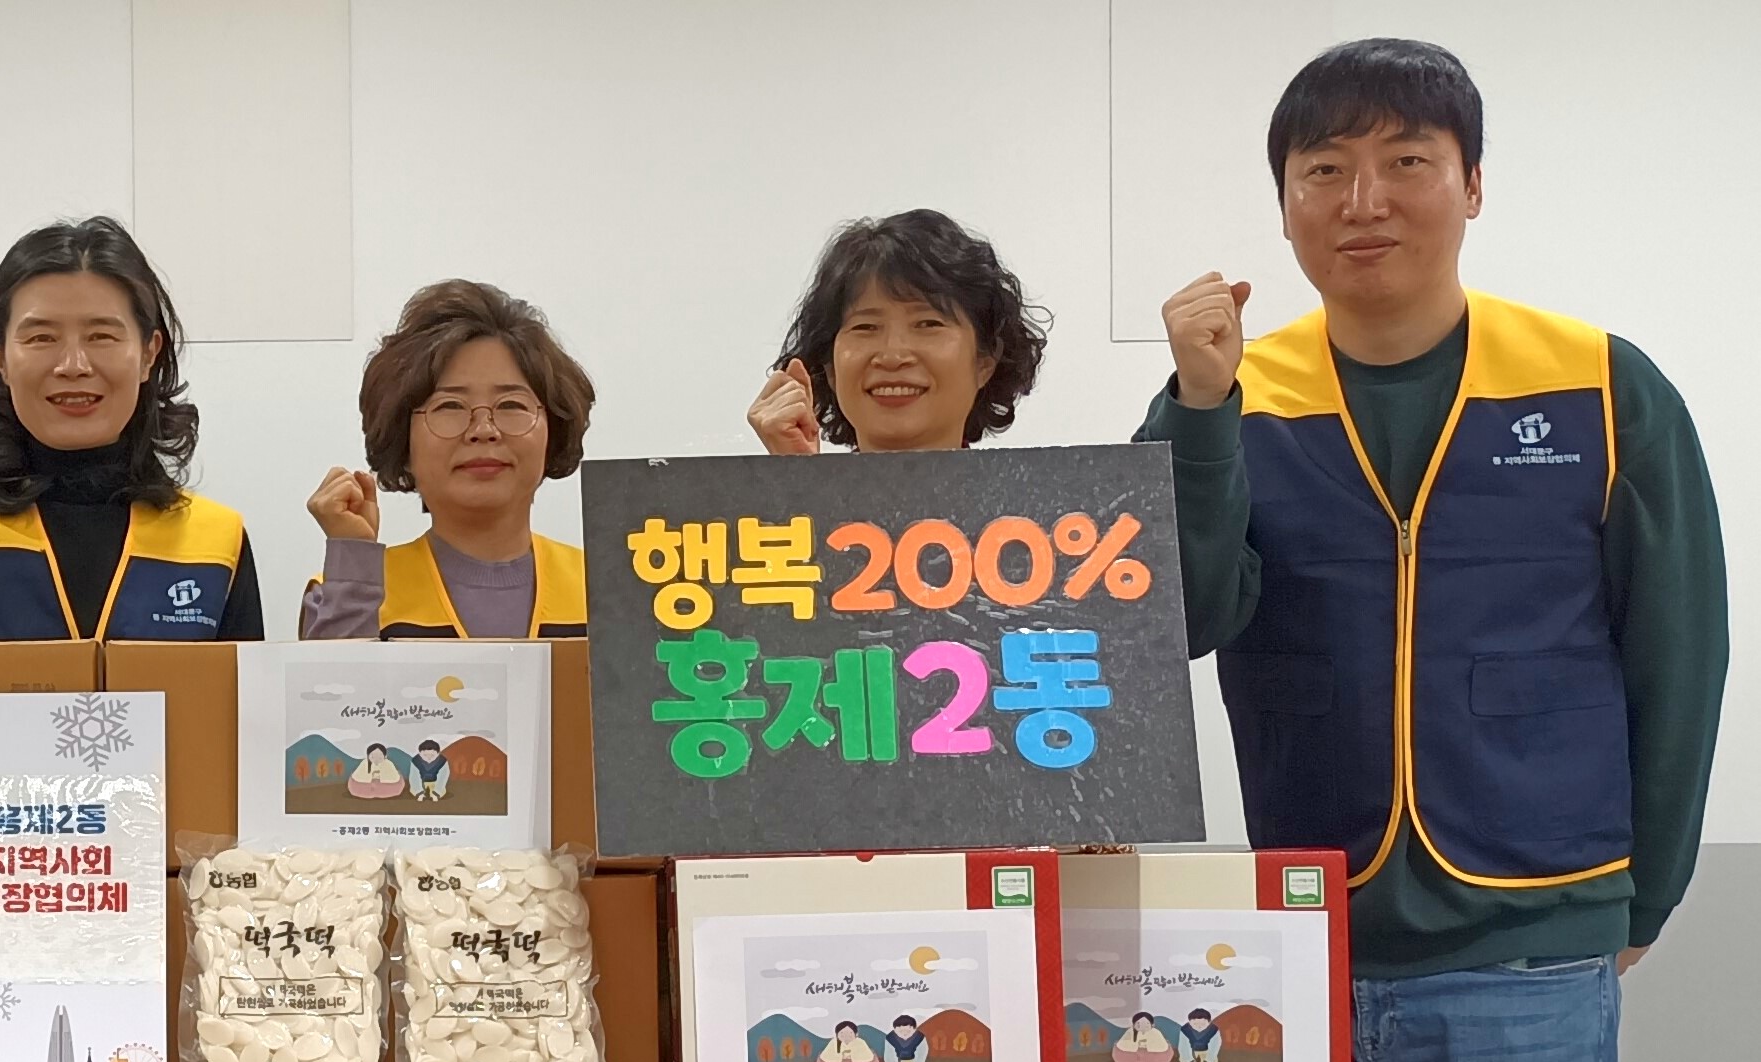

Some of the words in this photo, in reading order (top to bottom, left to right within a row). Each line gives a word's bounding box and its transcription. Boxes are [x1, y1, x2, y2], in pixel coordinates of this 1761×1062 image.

[652, 629, 1111, 778] 홍제2동
[226, 872, 257, 889] 농협
[244, 920, 335, 958] 떡국떡
[452, 929, 541, 965] 떡국떡
